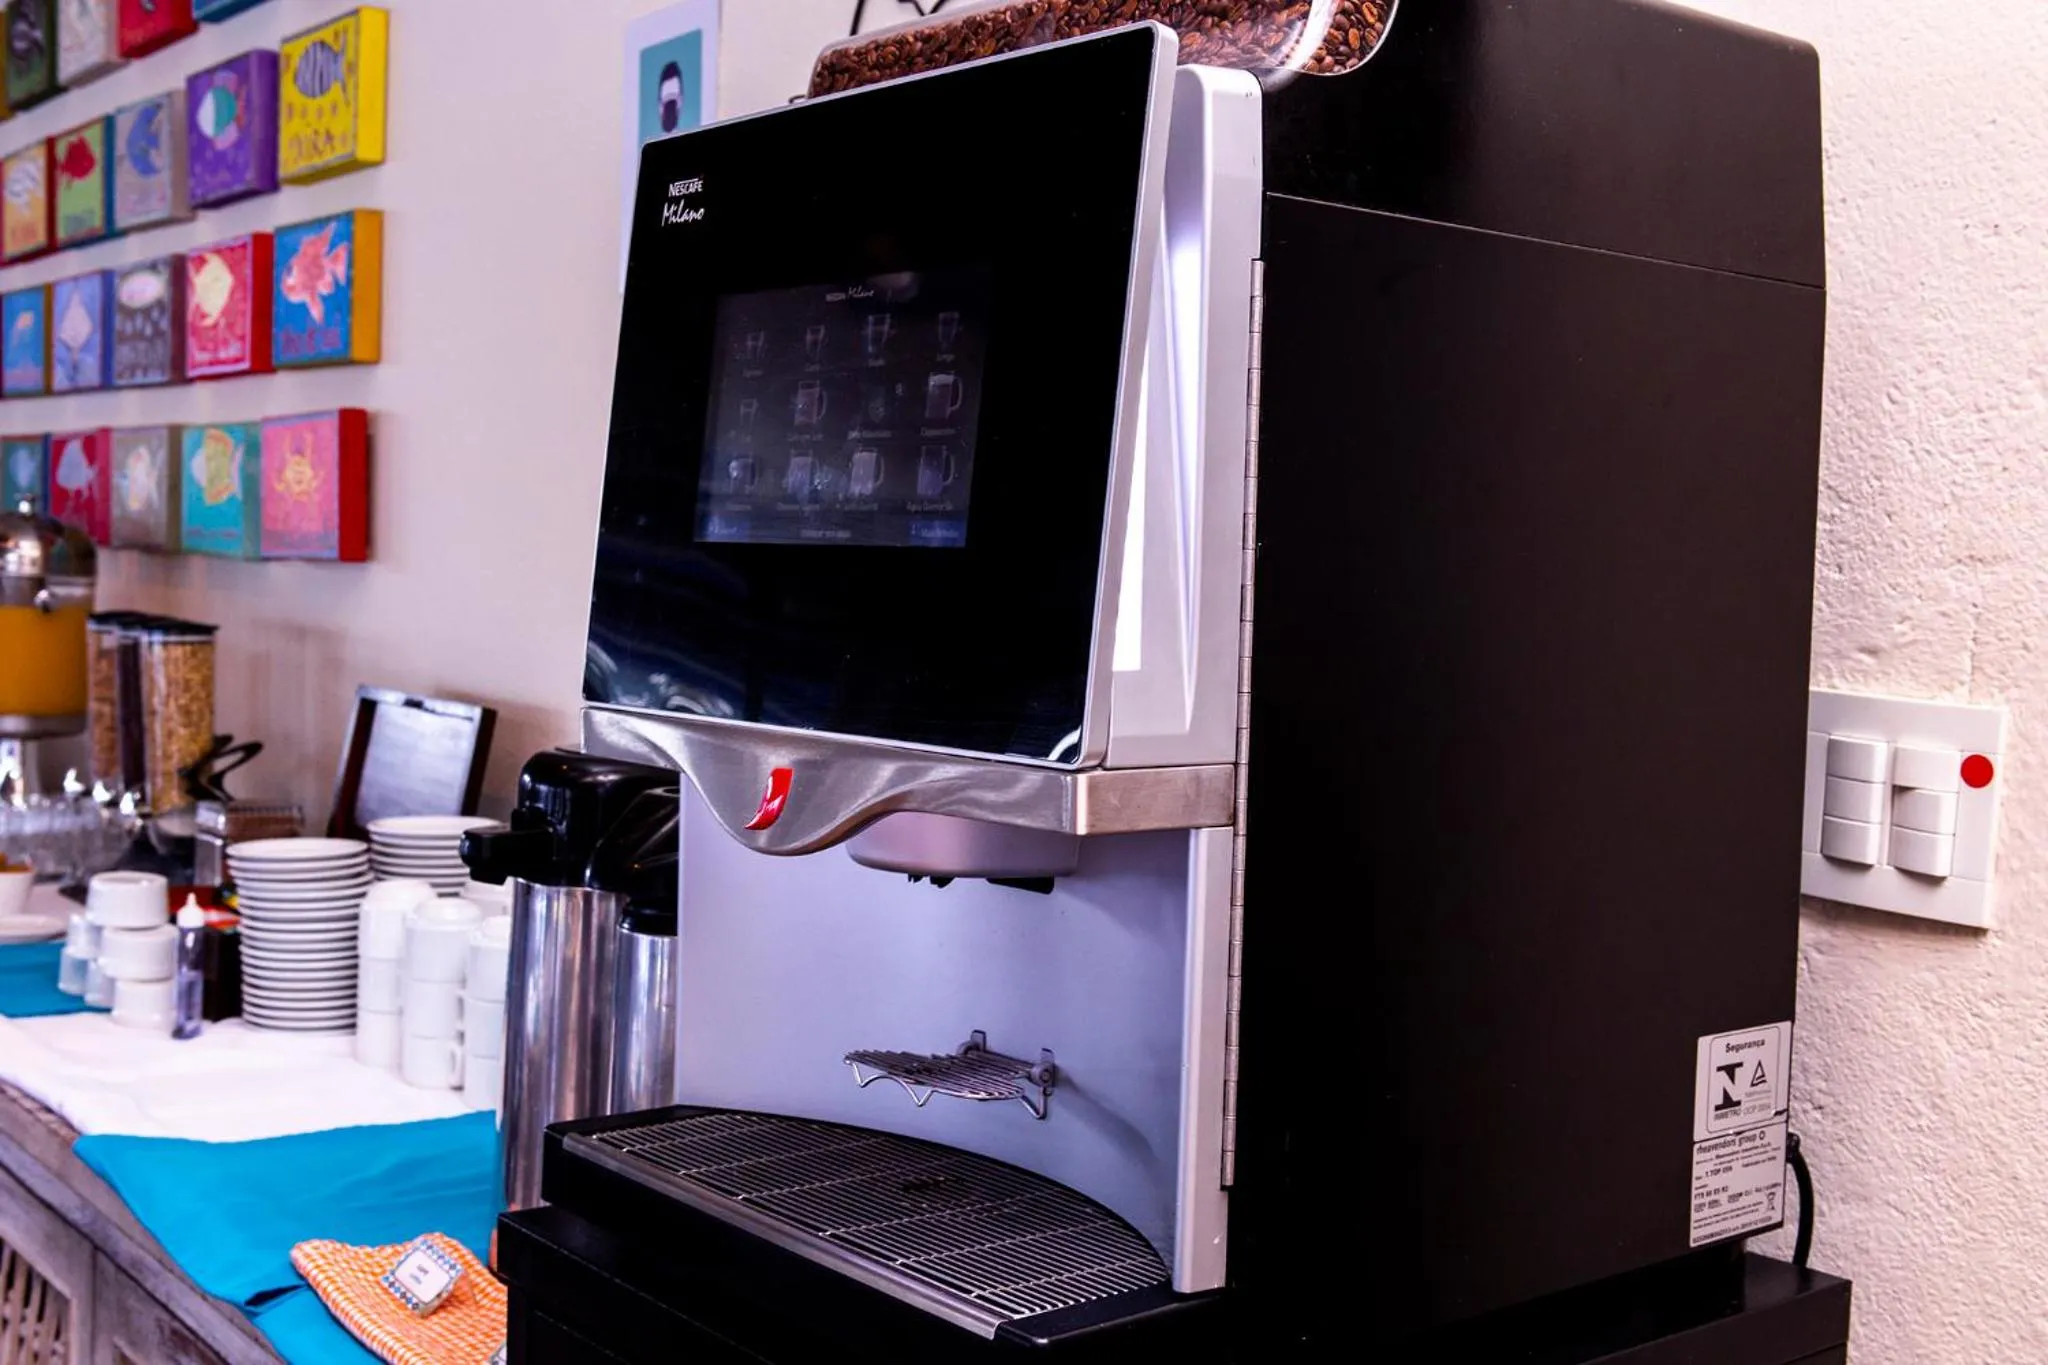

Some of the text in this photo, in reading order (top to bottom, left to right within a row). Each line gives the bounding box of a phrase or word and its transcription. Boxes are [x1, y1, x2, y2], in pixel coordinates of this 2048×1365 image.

[661, 199, 705, 227] Milano
[1725, 1038, 1766, 1053] Segurança
[1738, 1133, 1757, 1147] group
